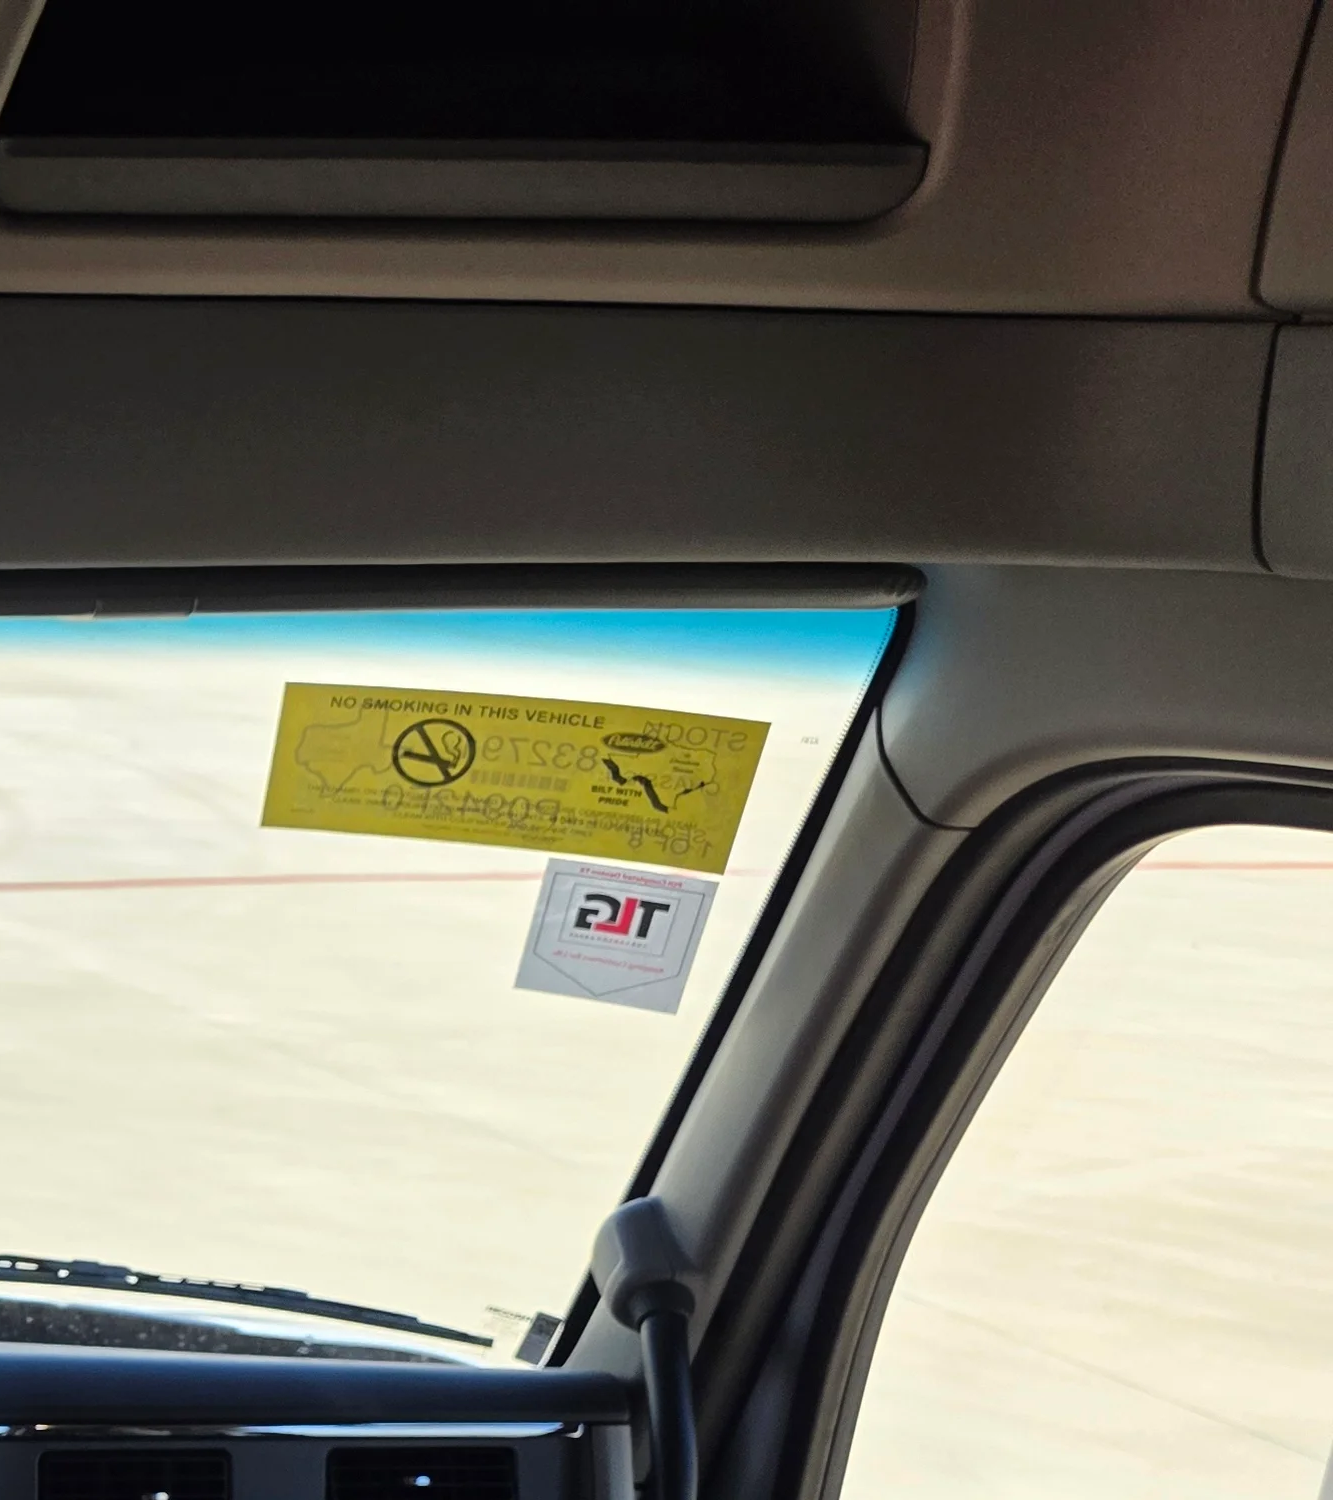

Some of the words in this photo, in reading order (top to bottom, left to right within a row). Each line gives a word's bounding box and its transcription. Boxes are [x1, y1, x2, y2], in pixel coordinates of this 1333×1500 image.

[330, 695, 357, 709] NO
[362, 697, 449, 715] SMOKING
[454, 702, 472, 717] IN
[478, 704, 520, 721] THIS
[525, 709, 607, 730] VEHICLE
[616, 786, 643, 798] WITH
[598, 796, 630, 807] PRIDE
